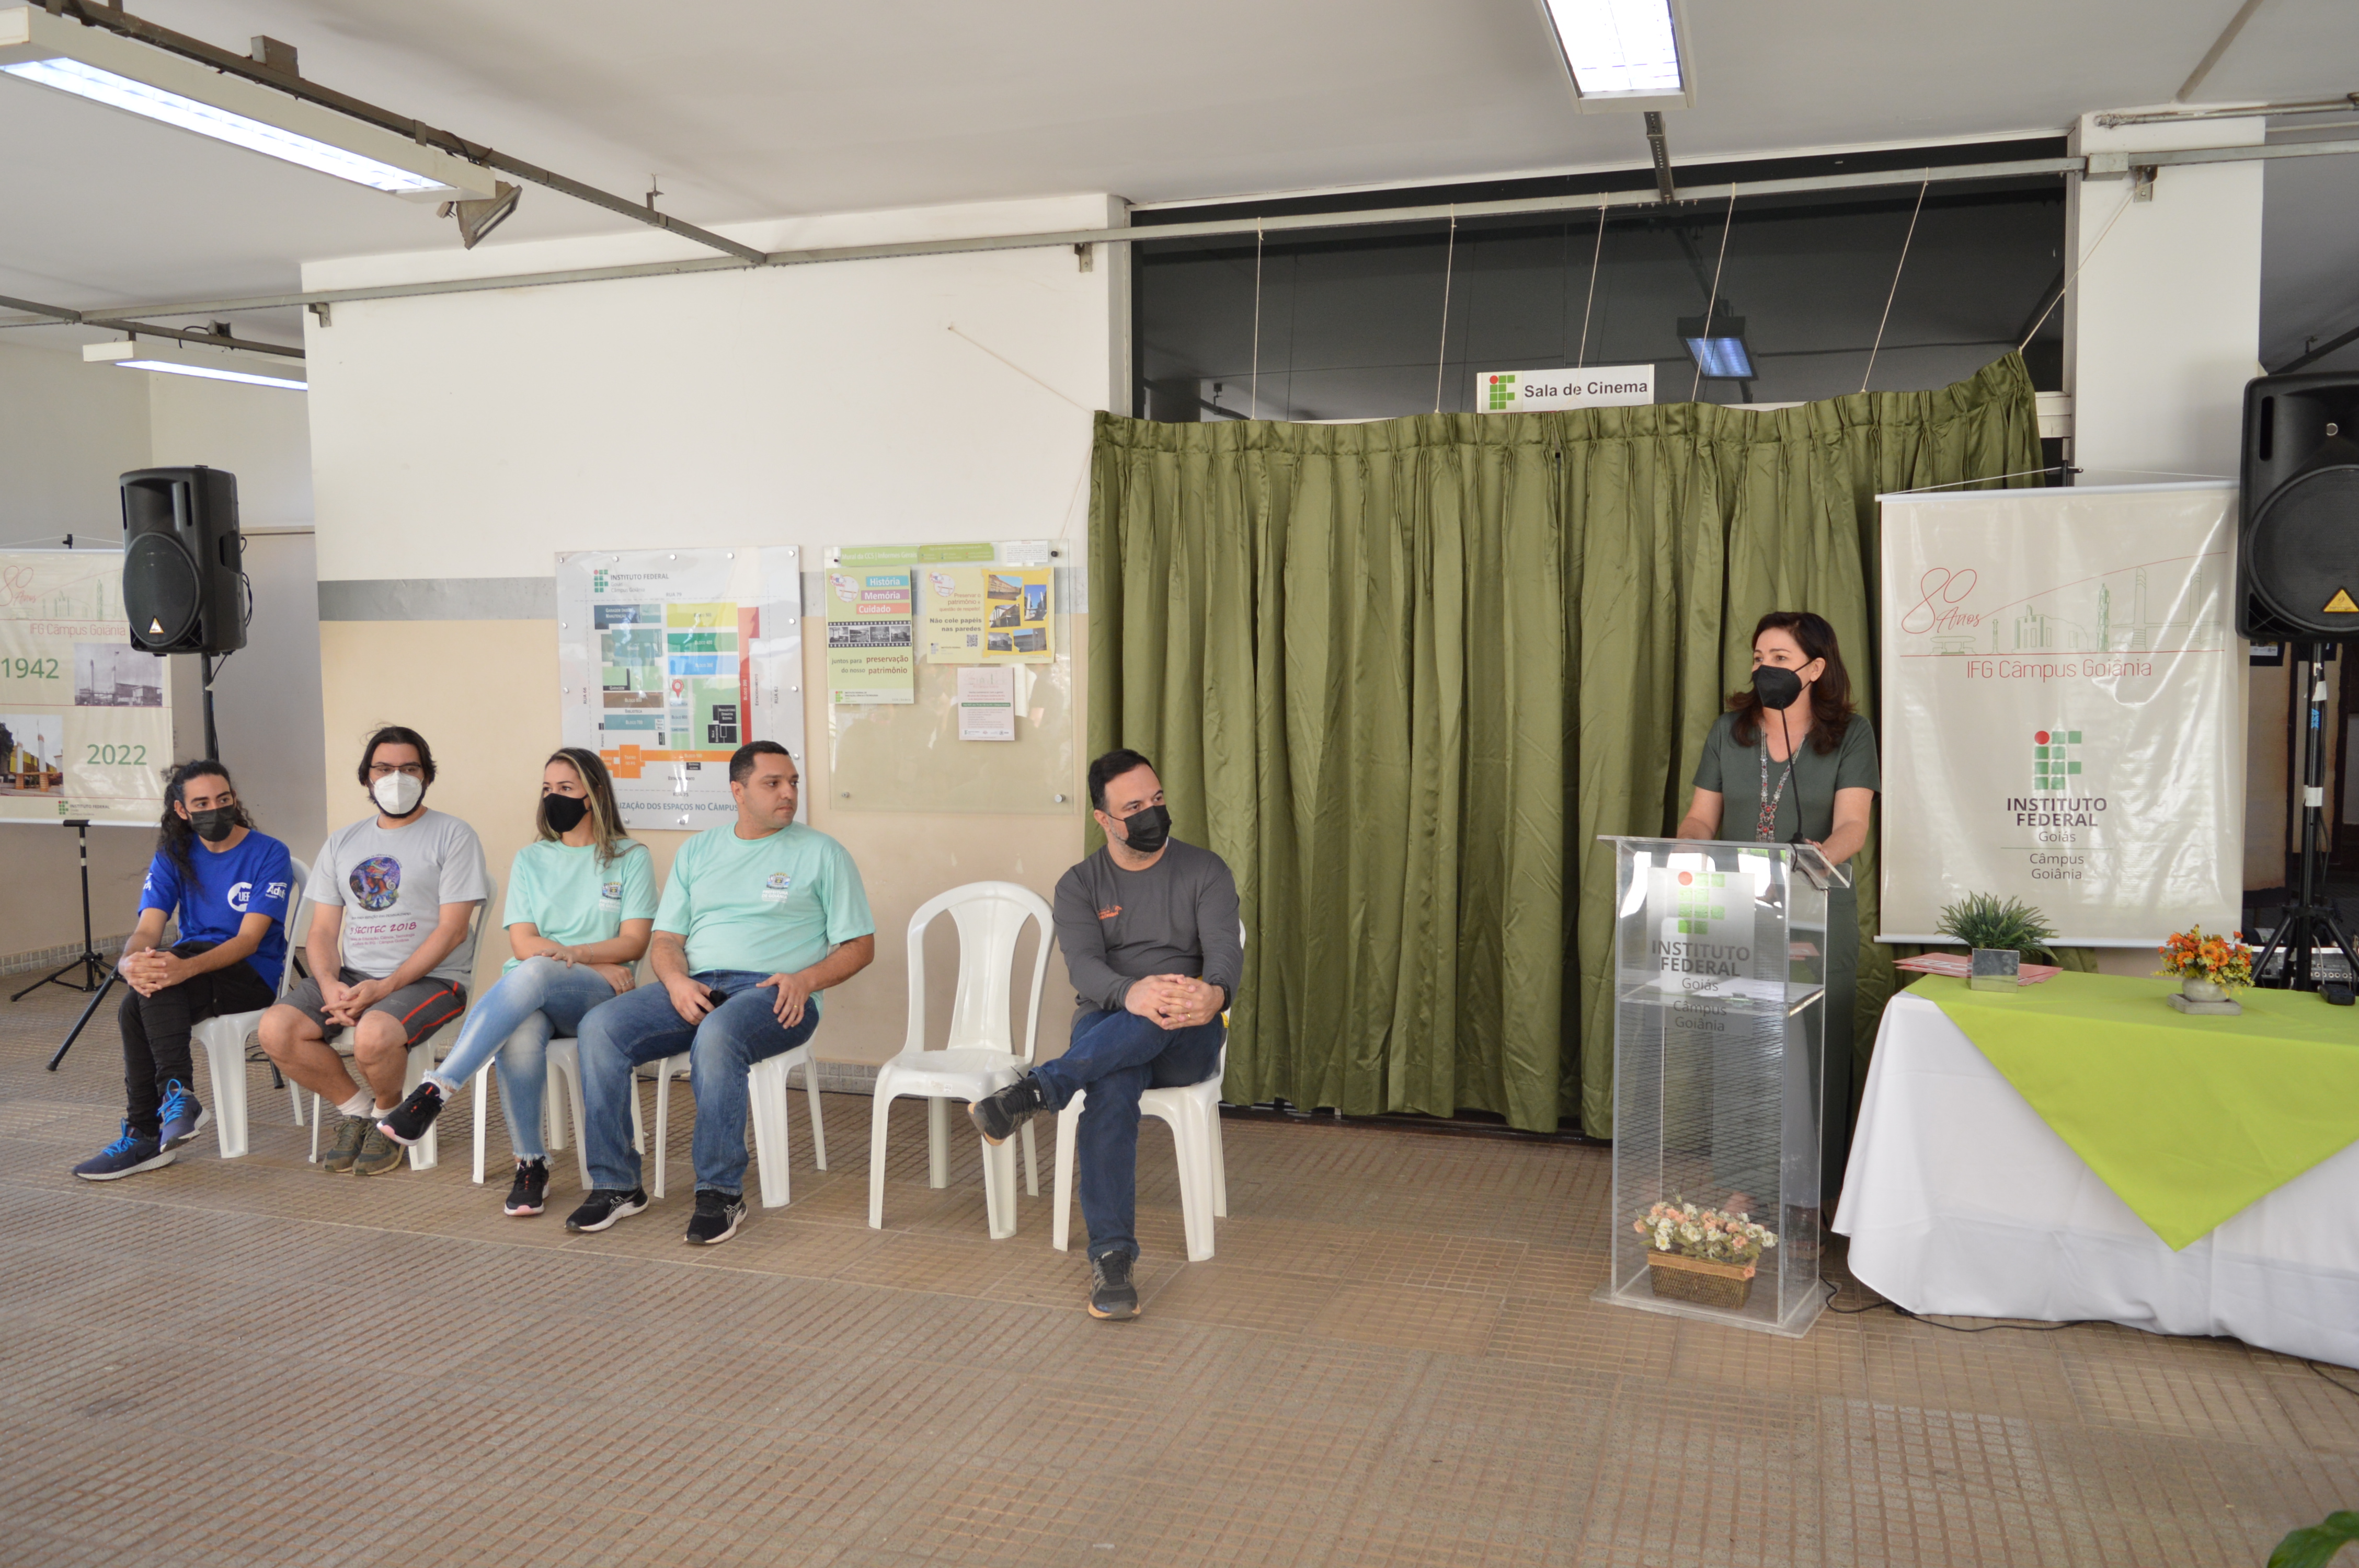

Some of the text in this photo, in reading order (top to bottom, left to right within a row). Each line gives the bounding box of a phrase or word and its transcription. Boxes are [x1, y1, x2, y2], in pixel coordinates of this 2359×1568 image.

[1524, 382, 1648, 398] Sala de Cinema
[869, 578, 900, 586] História
[864, 591, 900, 600] Memória
[1901, 567, 1977, 634] 80
[1936, 606, 1981, 633] Anos
[30, 623, 126, 638] IFG Câmpus Goiânia
[866, 655, 909, 664] preservação
[1, 658, 59, 679] 1942
[868, 666, 908, 675] patrimônio
[1967, 659, 2152, 683] IFG Câmpus Goiânia
[87, 744, 147, 765] 2022
[663, 803, 693, 812] ESPAÇOS
[2006, 798, 2108, 812] INSTITUTO
[2016, 812, 2099, 827] FEDERAL
[2038, 830, 2076, 843] Goiás
[2029, 852, 2085, 868] Câmpus
[2031, 867, 2082, 880] Goiânia
[390, 921, 417, 932] 2018
[1651, 940, 1750, 962] INSTITUTO
[1661, 956, 1741, 977] FEDERAL
[1681, 977, 1719, 991] Goiás
[1673, 1000, 1727, 1017] Câmpus
[1675, 1016, 1725, 1032] Goiânia
